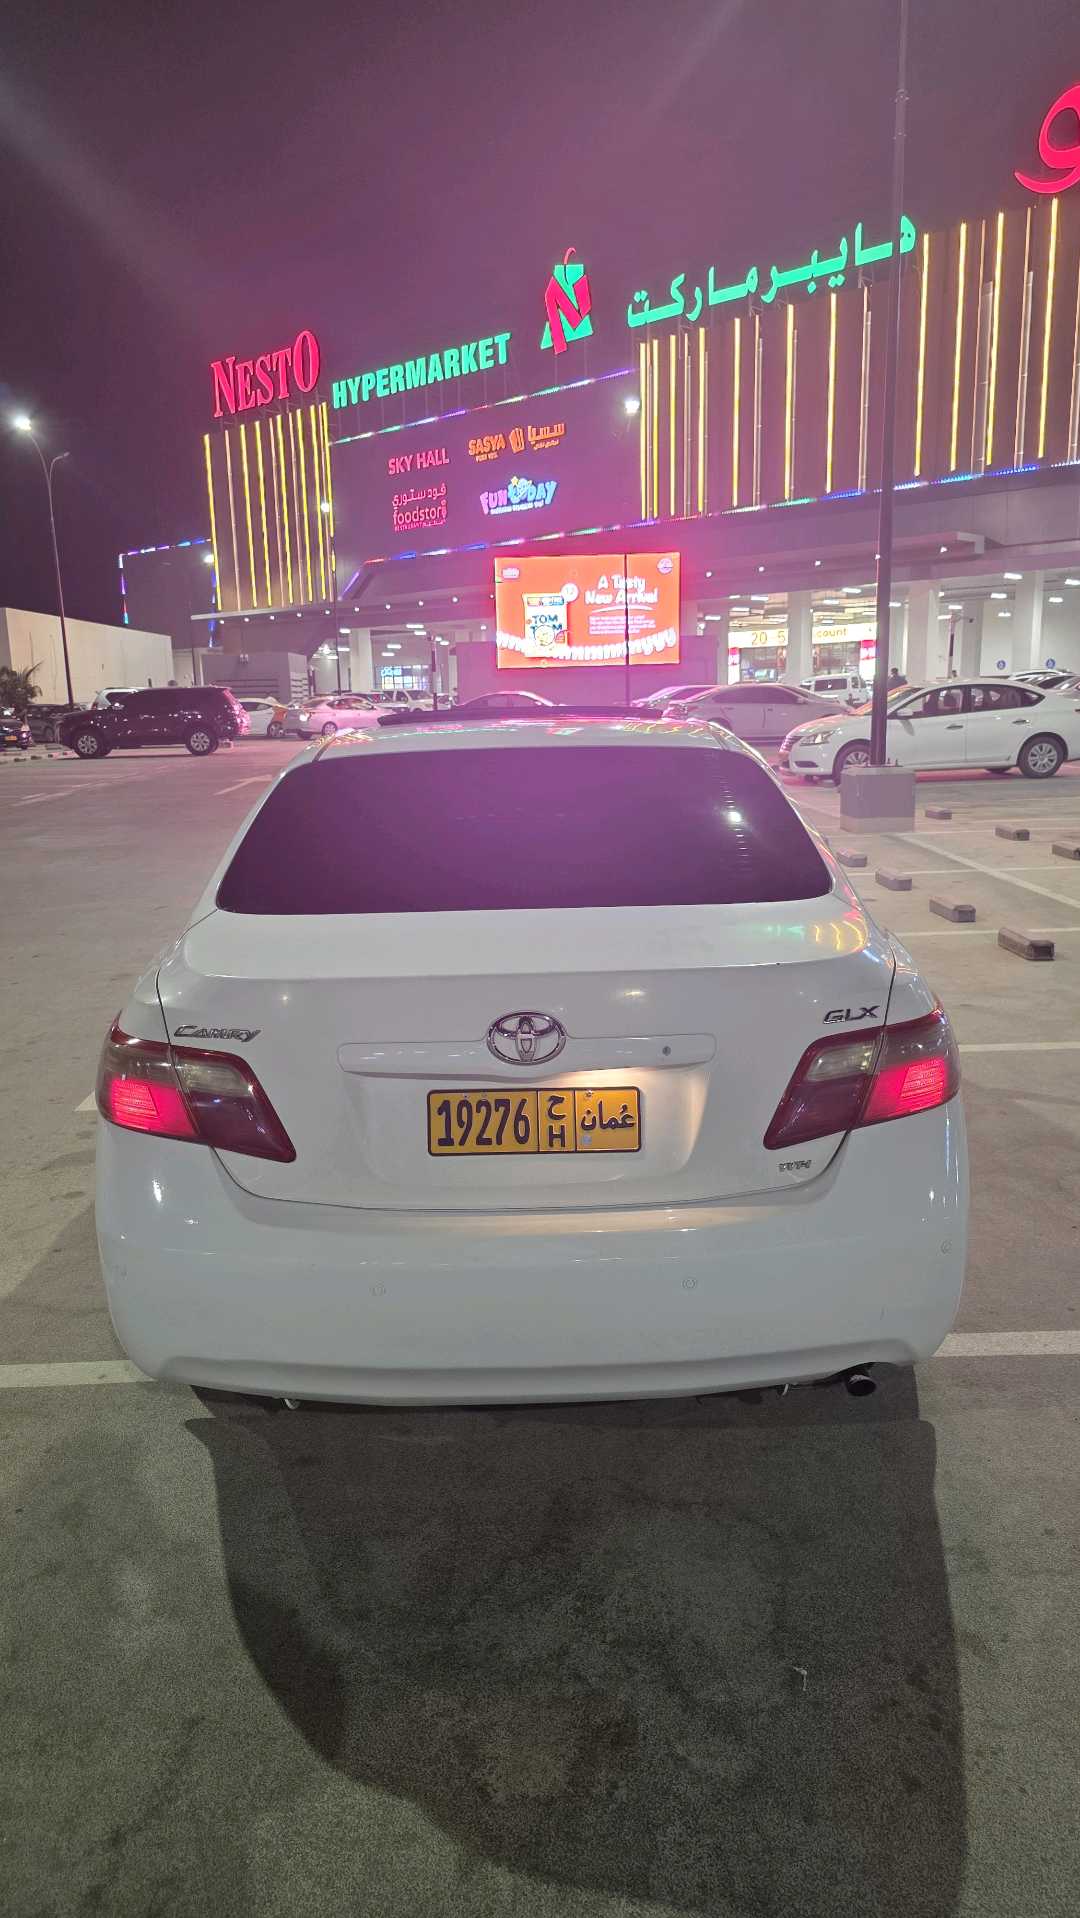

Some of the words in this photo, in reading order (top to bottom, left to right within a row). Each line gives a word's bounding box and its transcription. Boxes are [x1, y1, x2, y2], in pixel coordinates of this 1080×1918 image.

[210, 330, 320, 418] NESTO
[332, 332, 511, 409] HYPERMARKET
[468, 434, 506, 456] SASYA
[388, 454, 414, 475] SKY
[416, 447, 450, 470] HALL
[479, 489, 508, 515] FUN
[598, 575, 609, 590] A
[532, 614, 558, 624] TOM
[823, 1005, 881, 1025] GLX
[436, 1098, 531, 1147] 19276
[548, 1124, 566, 1148] H
